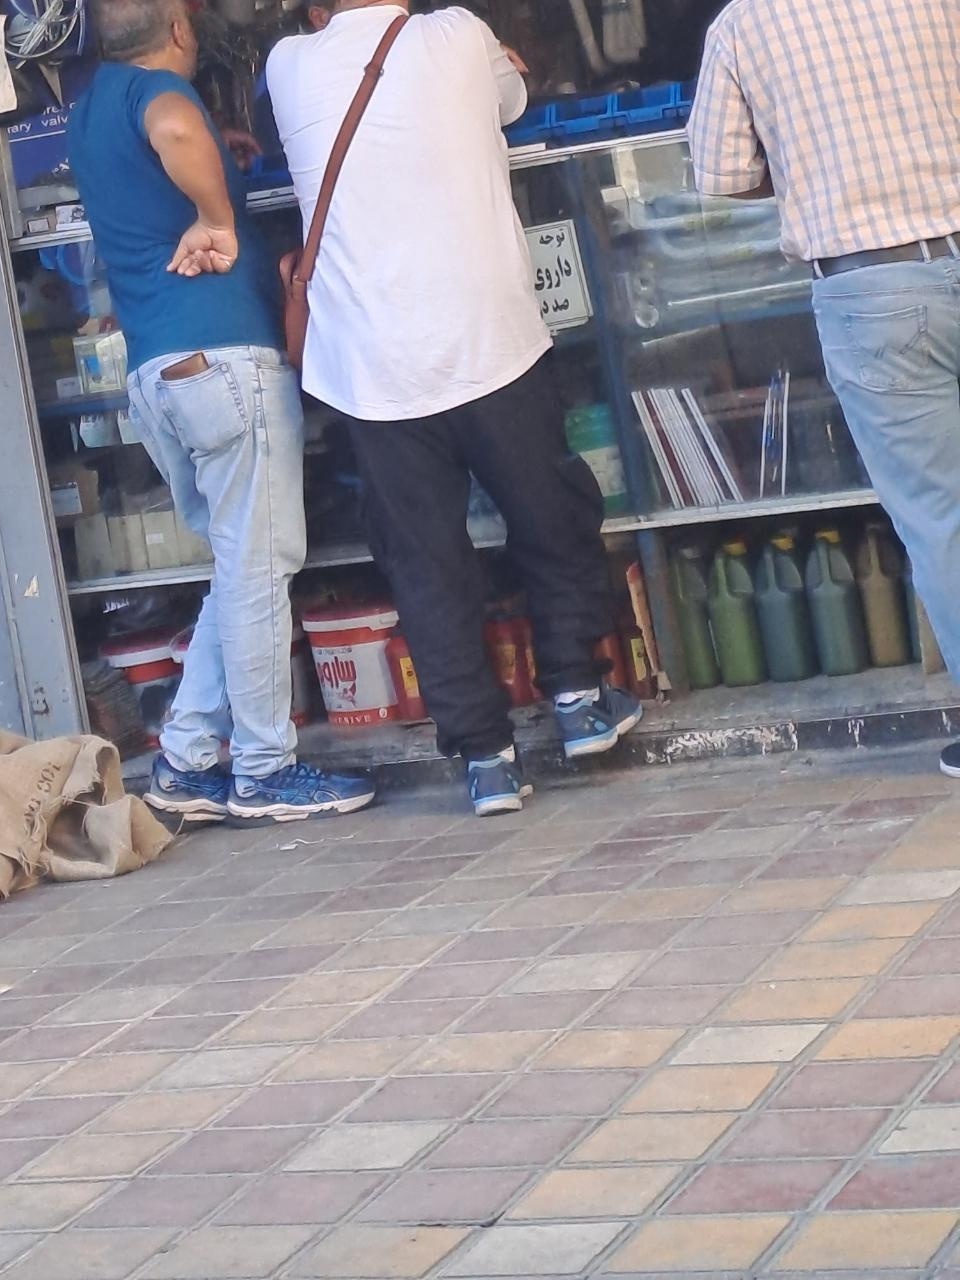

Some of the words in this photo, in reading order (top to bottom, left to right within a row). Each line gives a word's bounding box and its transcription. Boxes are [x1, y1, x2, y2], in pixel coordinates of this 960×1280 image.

[7, 122, 32, 134] rary
[41, 115, 69, 128] valv
[534, 255, 572, 291] داروی
